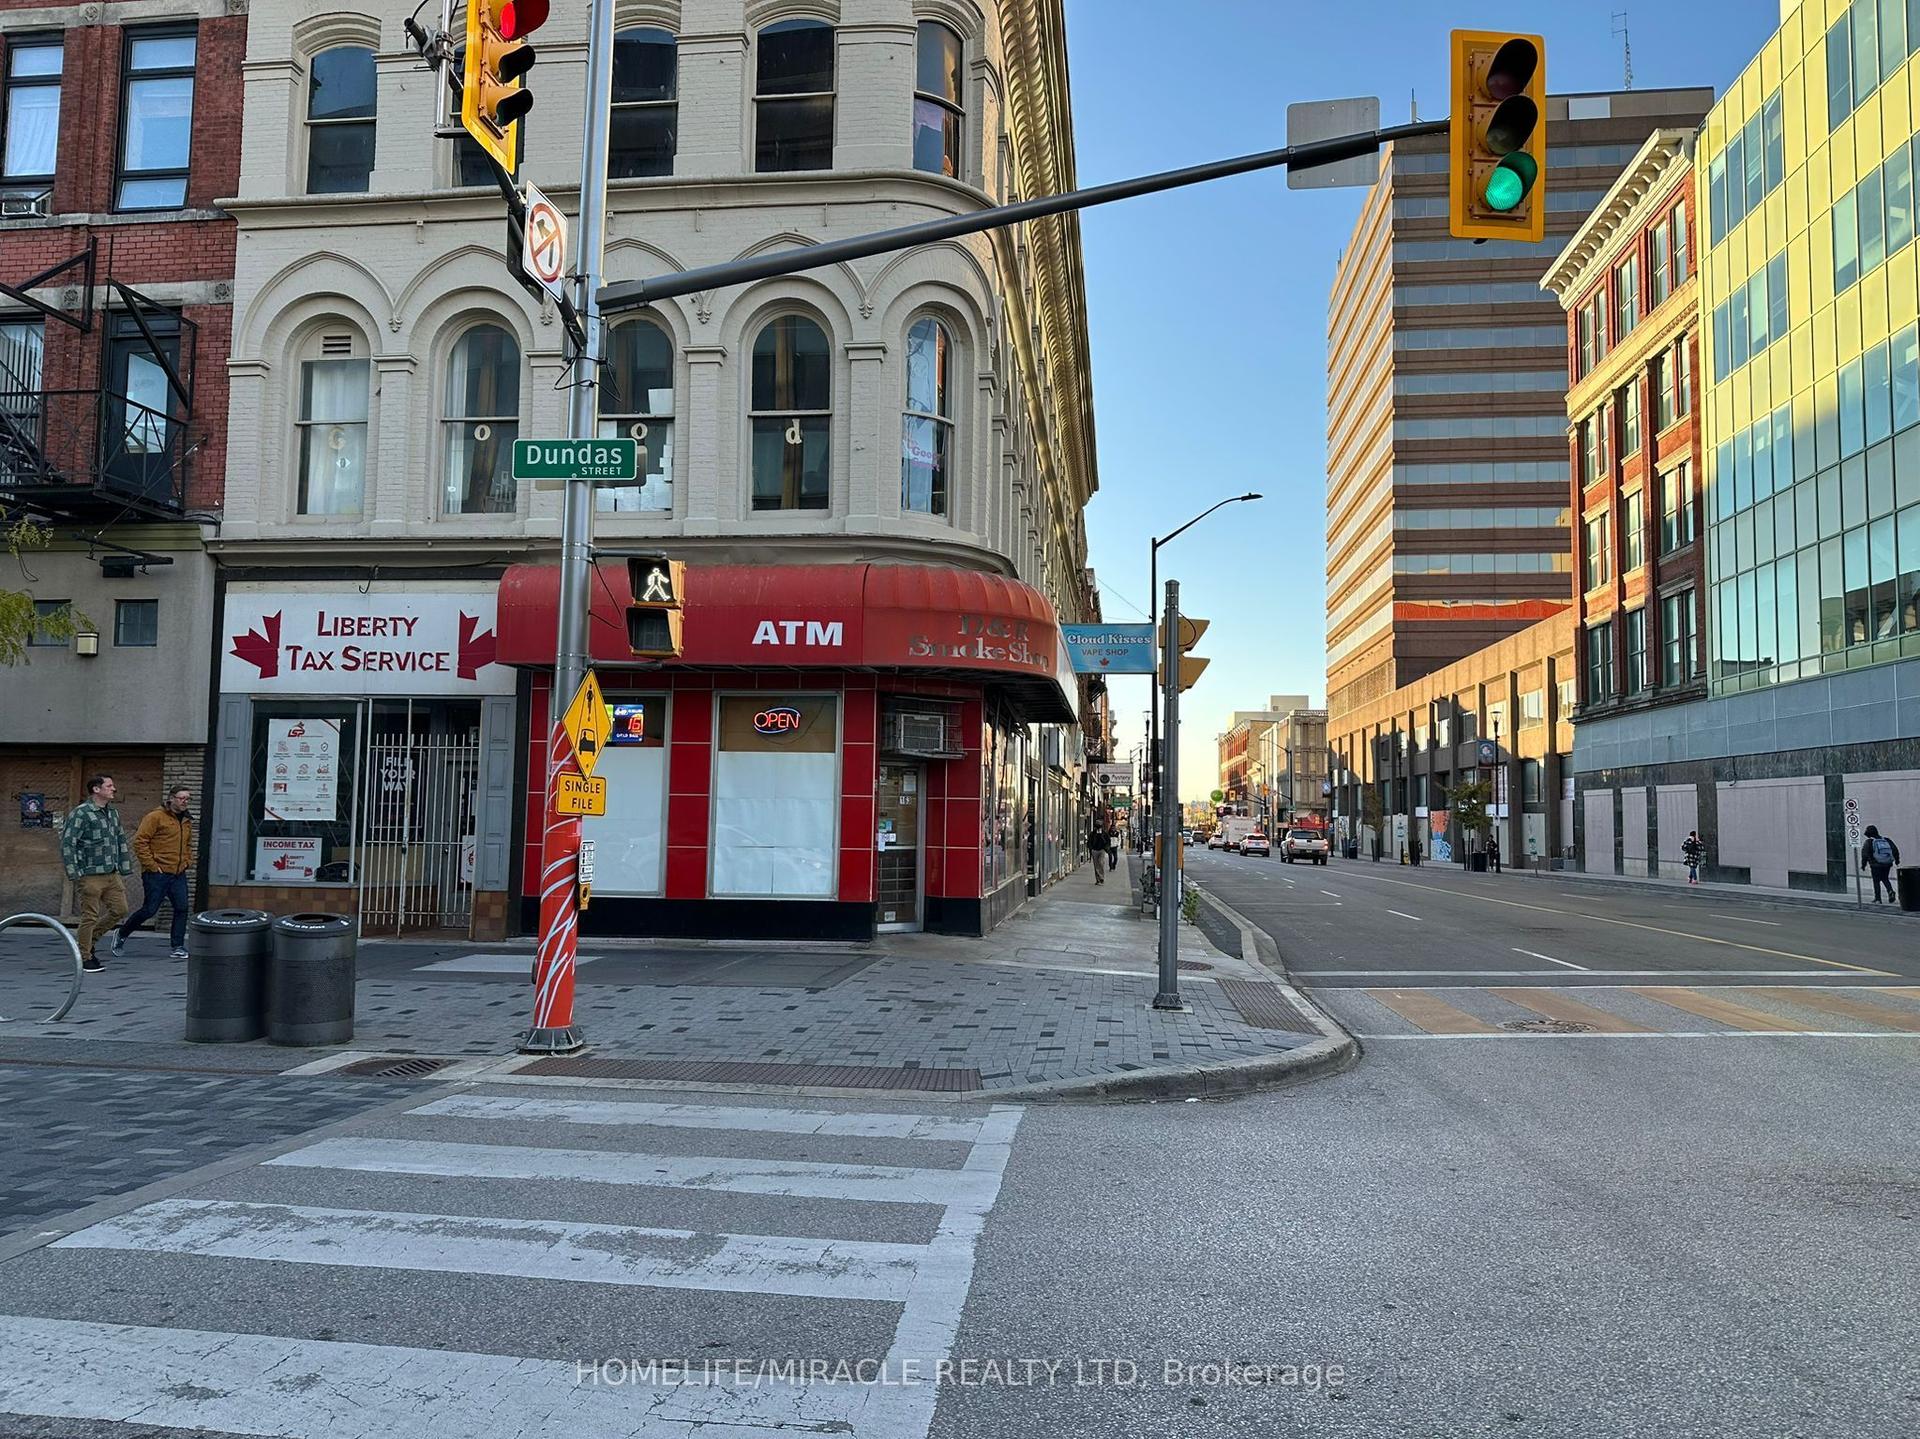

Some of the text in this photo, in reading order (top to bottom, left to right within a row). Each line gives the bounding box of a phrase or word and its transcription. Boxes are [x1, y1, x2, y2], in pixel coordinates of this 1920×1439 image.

[785, 418, 802, 445] d
[526, 443, 622, 465] Dundas
[581, 466, 622, 476] STREET
[317, 611, 419, 637] LIBERTY
[751, 620, 843, 646] ATM
[1067, 633, 1152, 645] Cloud Kisses
[286, 645, 450, 672] TAX SERVICE
[908, 634, 1049, 672] Smoke Shop
[1081, 648, 1129, 656] VAPE SHOP
[627, 717, 641, 731] 16
[754, 712, 800, 729] OPEN
[380, 768, 416, 779] YOUR
[564, 780, 601, 794] SINGLE
[571, 797, 593, 810] FILE
[263, 841, 315, 849] INCOME TAX
